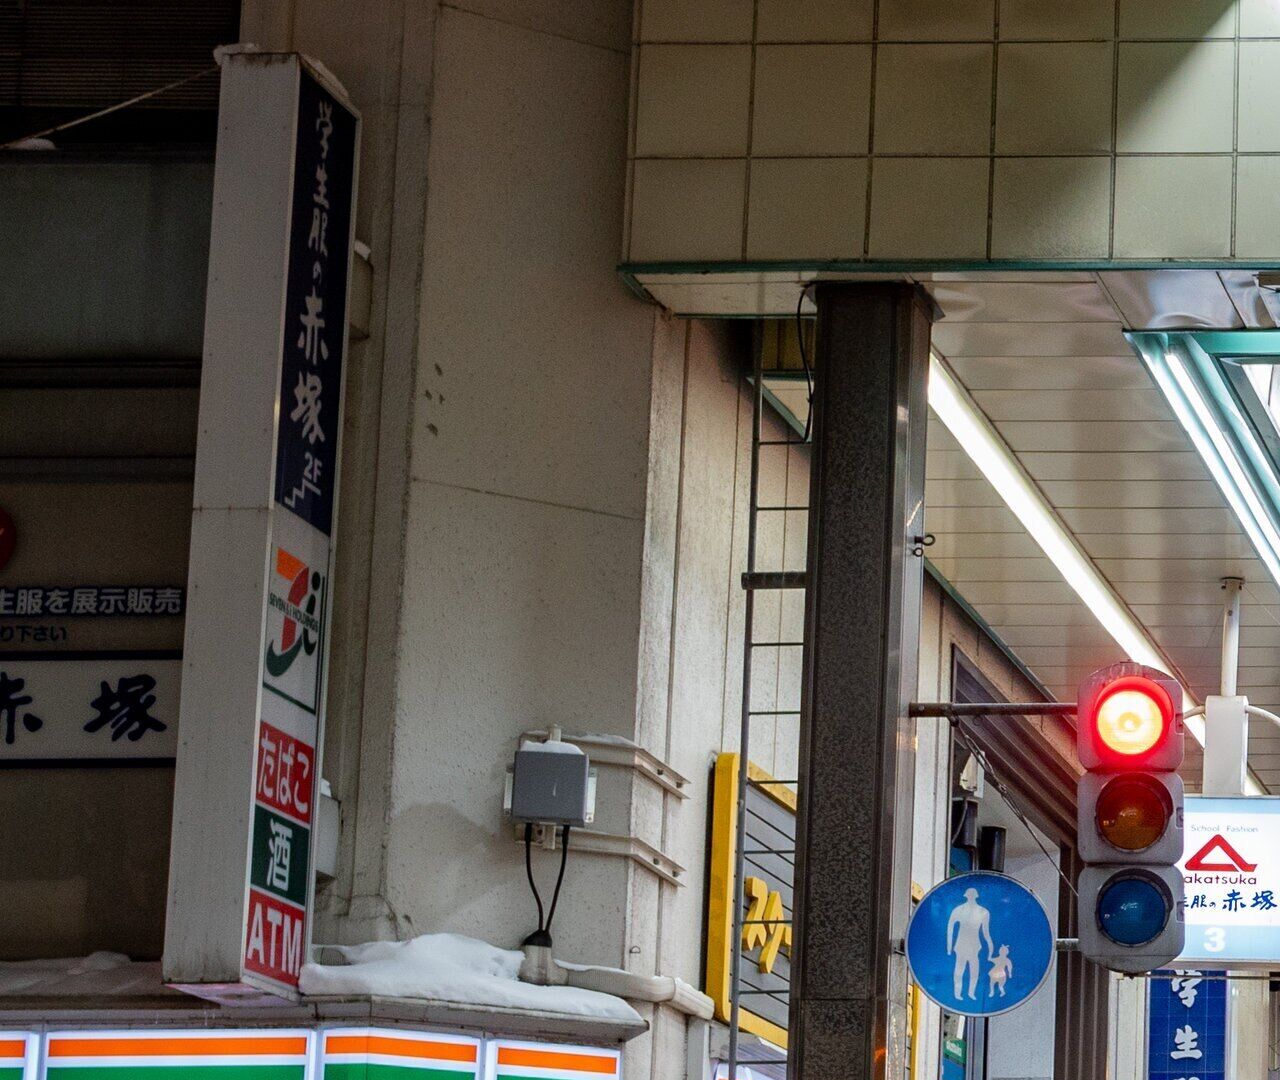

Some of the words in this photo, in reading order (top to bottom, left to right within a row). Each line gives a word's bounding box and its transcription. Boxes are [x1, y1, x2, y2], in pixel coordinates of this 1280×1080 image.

[303, 452, 322, 482] 2F
[258, 731, 309, 815] たばこ
[267, 818, 293, 892] 酒
[1183, 874, 1257, 885] akatsuka
[247, 901, 303, 979] ATM
[1203, 926, 1226, 953] 3
